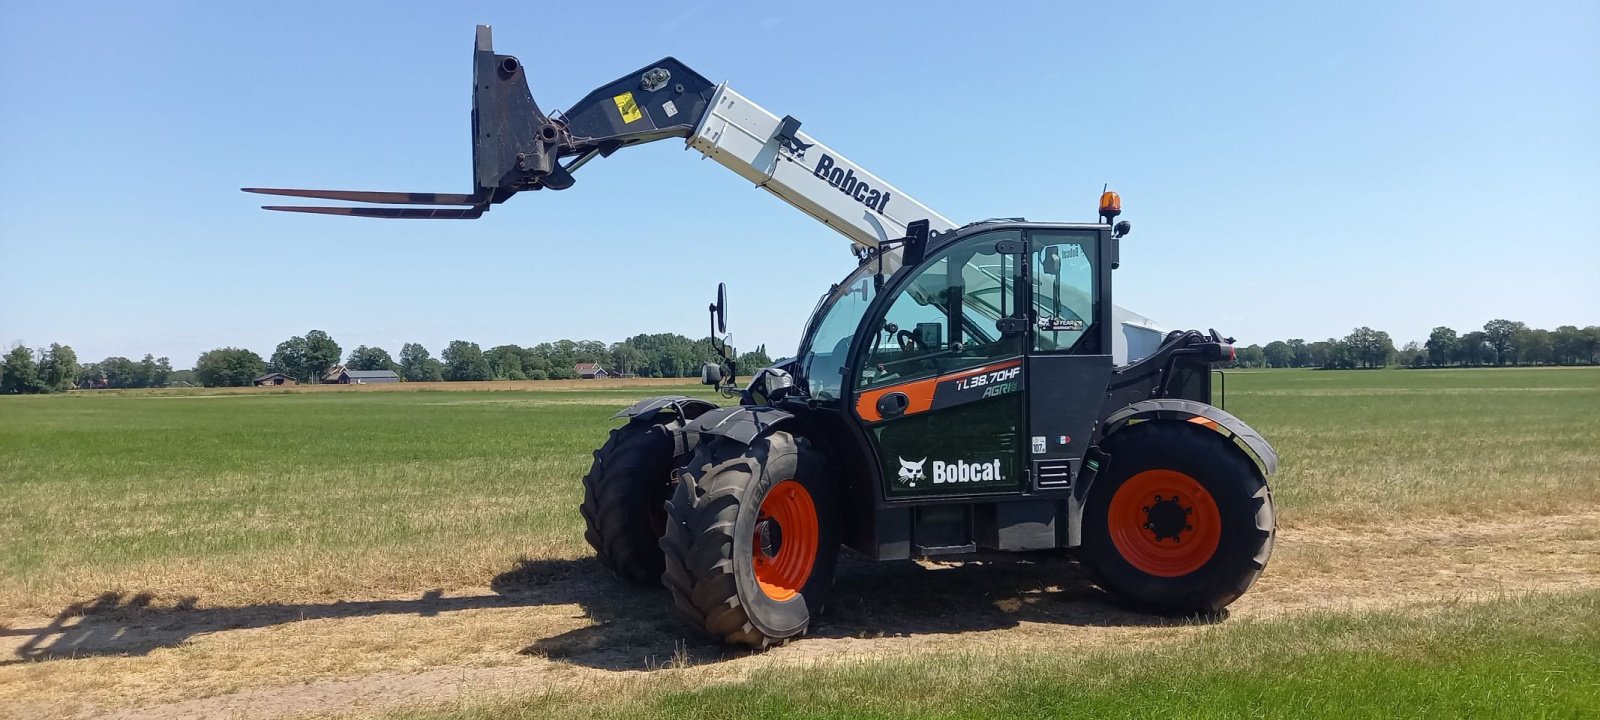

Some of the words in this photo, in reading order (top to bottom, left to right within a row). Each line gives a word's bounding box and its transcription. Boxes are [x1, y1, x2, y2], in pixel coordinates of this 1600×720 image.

[813, 153, 891, 215] Bobcat
[956, 367, 1021, 391] TL38.70HF
[932, 459, 1001, 484] Bobcat
